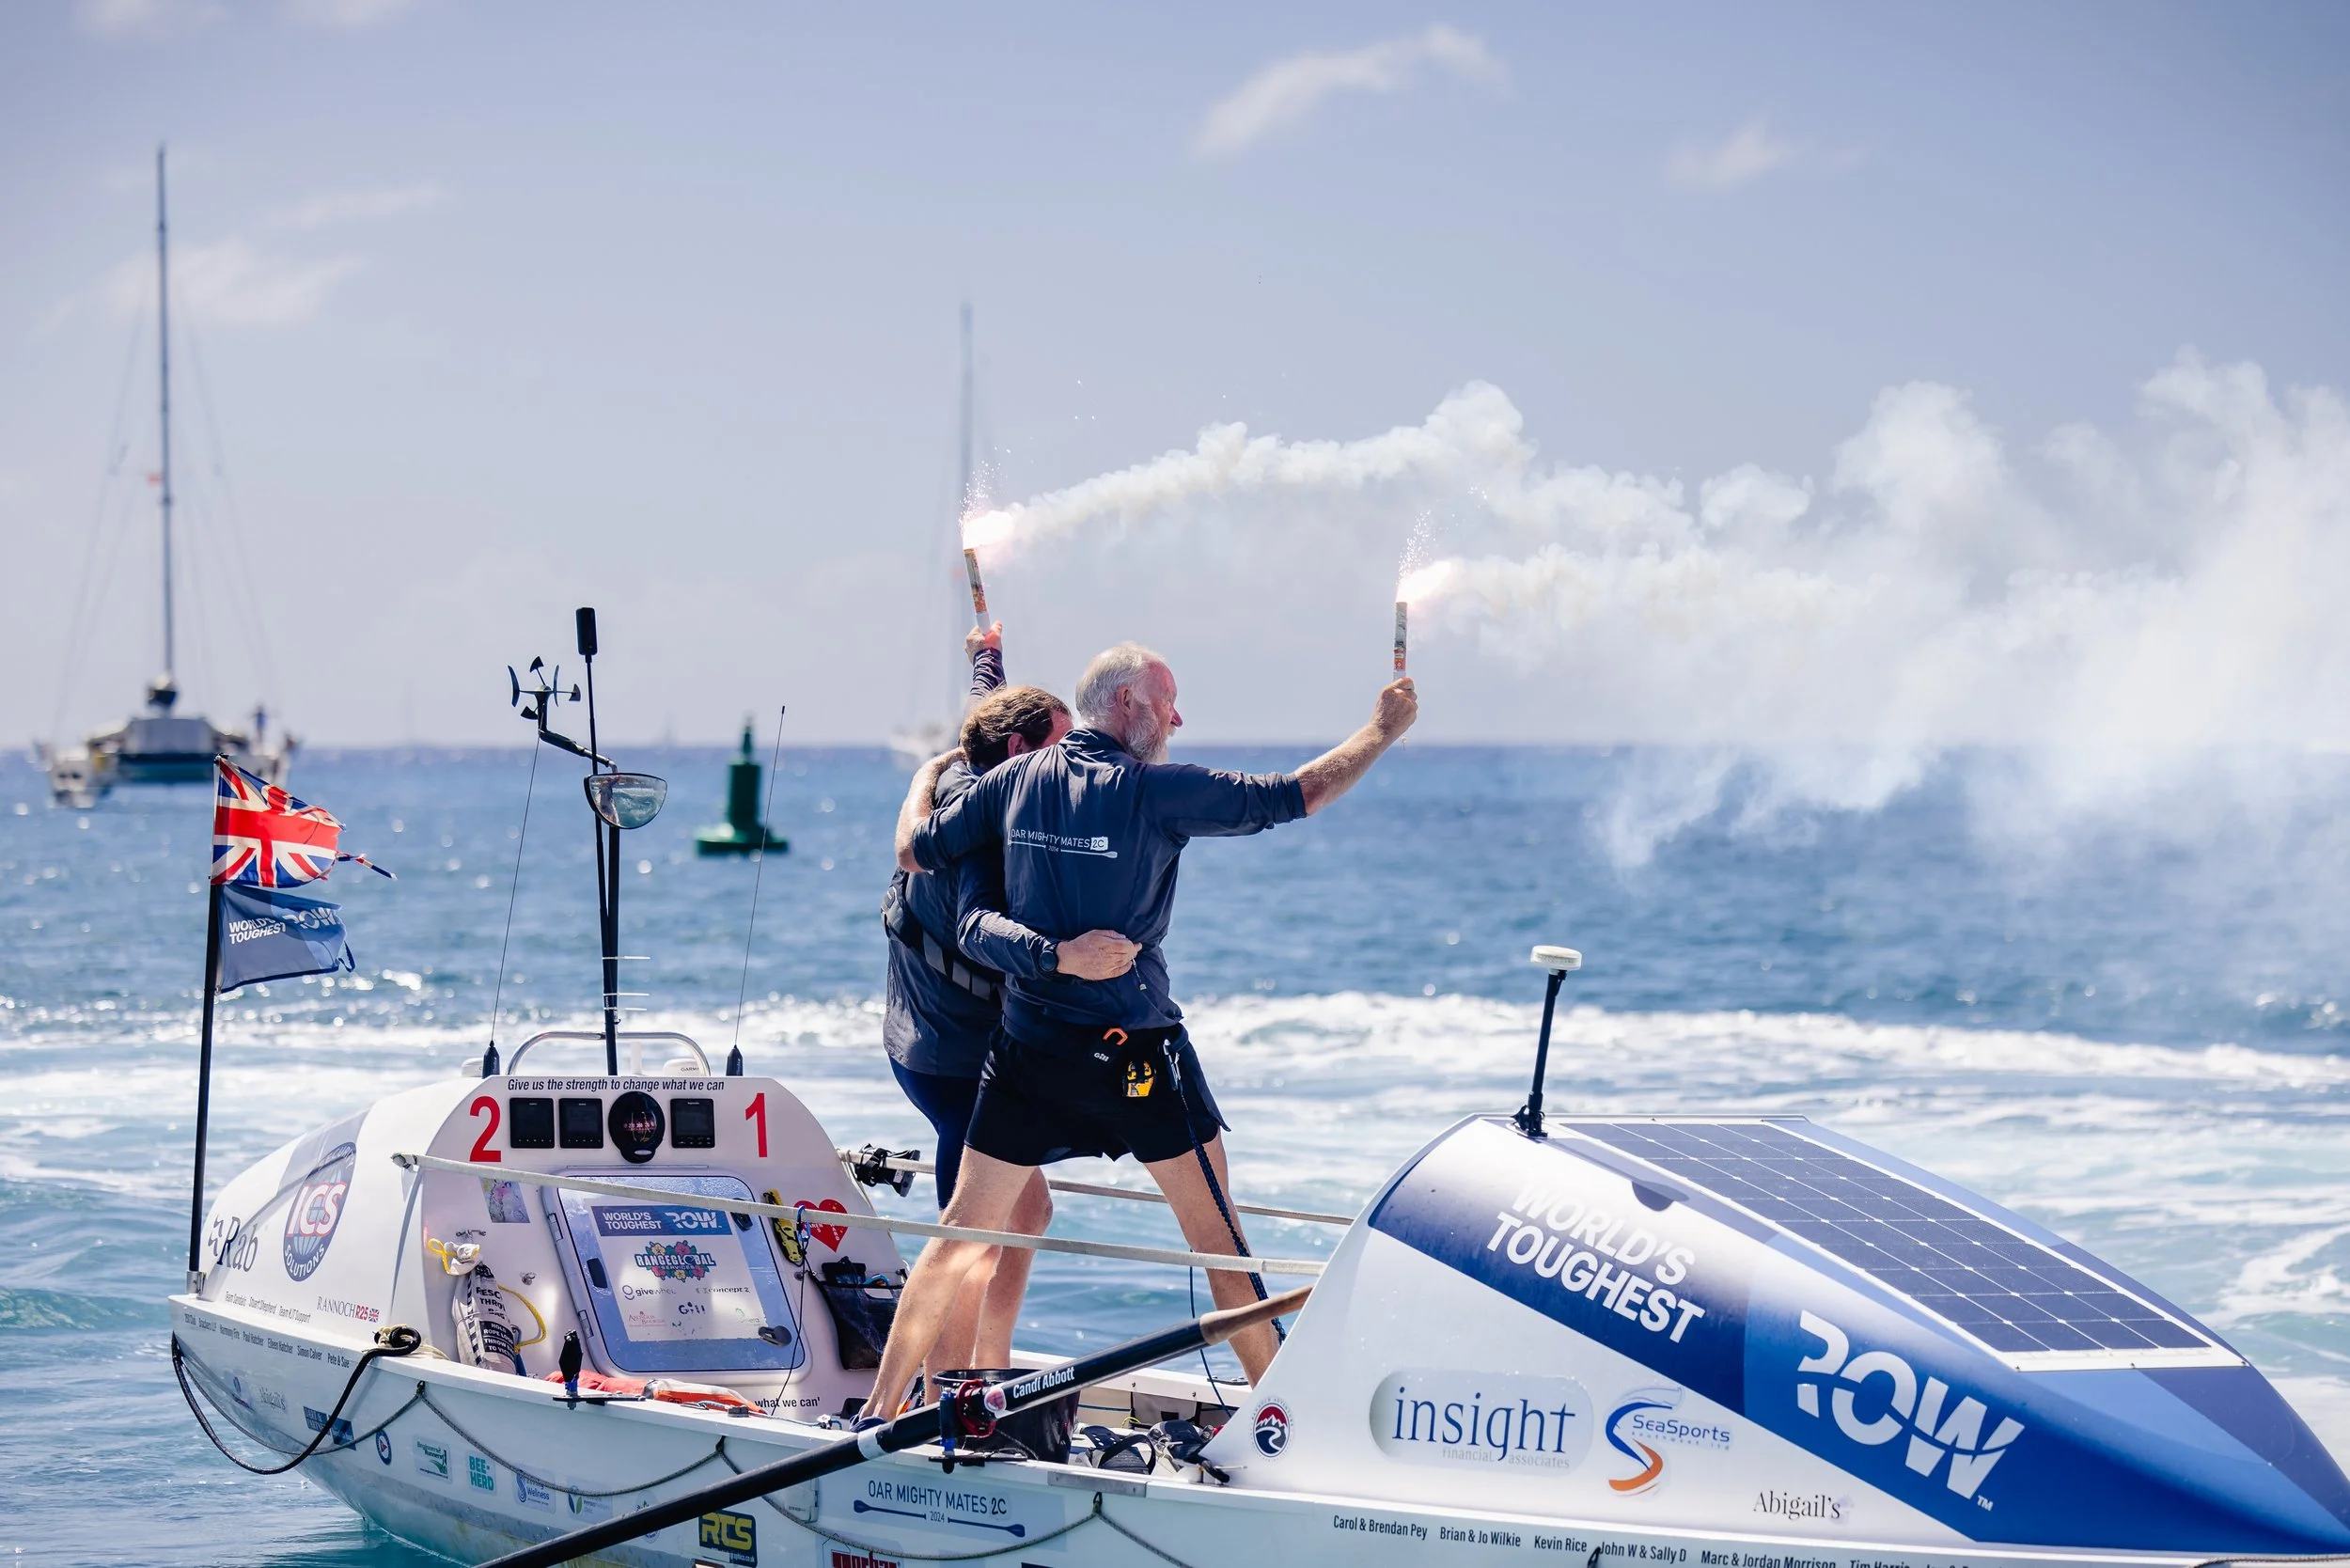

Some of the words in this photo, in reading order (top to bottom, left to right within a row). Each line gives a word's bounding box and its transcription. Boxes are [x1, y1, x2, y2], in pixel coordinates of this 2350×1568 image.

[1010, 828, 1026, 839] OAR
[1027, 830, 1059, 844] MIGHTY
[1061, 837, 1090, 848] MATES
[1092, 839, 1104, 848] 2C
[229, 922, 286, 945] TOUGHEST
[1093, 1052, 1109, 1062] Gill
[508, 1079, 529, 1090] Give
[532, 1081, 544, 1090] us
[547, 1079, 563, 1090] the
[566, 1079, 607, 1092] strength
[611, 1080, 620, 1090] to
[623, 1079, 659, 1092] change
[662, 1079, 686, 1090] what
[689, 1081, 704, 1090] we
[707, 1081, 725, 1090] can
[470, 1096, 501, 1162] 2
[744, 1092, 768, 1158] 1
[286, 1182, 347, 1237] ICS
[603, 1212, 651, 1221] WORLD'S
[665, 1212, 717, 1229] ROW
[604, 1220, 662, 1230] TOUGHEST
[1512, 1181, 1696, 1286] WORLD'S
[217, 1216, 258, 1273] Rab
[285, 1244, 325, 1277] SOLUTIONS
[1486, 1211, 1706, 1343] TOUGHEST
[317, 1296, 356, 1318] RANNOCH
[355, 1305, 369, 1321] R25
[480, 1297, 506, 1312] THRO
[483, 1338, 507, 1348] THROW
[1013, 1377, 1041, 1399] Candi
[1042, 1367, 1075, 1389] Abbott
[755, 1398, 779, 1408] what
[782, 1400, 797, 1408] we
[800, 1397, 821, 1407] can'
[1797, 1309, 2026, 1500] ROW
[1392, 1386, 1575, 1462] insight
[1633, 1415, 1731, 1443] SeaSports
[1442, 1447, 1495, 1463] financial
[1509, 1453, 1570, 1469] associates
[470, 1471, 494, 1491] HERD
[869, 1480, 892, 1499] OAR
[897, 1484, 942, 1507] MIGHTY
[946, 1492, 987, 1514] MATES
[991, 1497, 1007, 1514] 2C
[1753, 1490, 1841, 1521] Abigail's
[931, 1511, 945, 1523] 2024
[1333, 1514, 1357, 1530] Carol
[1359, 1518, 1367, 1531] &
[1369, 1519, 1408, 1536] Brendan
[1410, 1524, 1428, 1541] Pey
[1440, 1527, 1465, 1542] Brian
[1467, 1529, 1476, 1543] &
[1478, 1530, 1488, 1544] Jo
[1490, 1531, 1521, 1547] Wilkie
[1534, 1535, 1562, 1551] Kevin
[1565, 1537, 1587, 1553] Rice
[1599, 1542, 1624, 1557] John
[1627, 1544, 1637, 1558] W
[1639, 1544, 1648, 1559] &
[1650, 1545, 1677, 1564] Sally
[1679, 1549, 1686, 1562] D
[1701, 1550, 1729, 1565] Marc
[1731, 1553, 1740, 1566] &
[1742, 1553, 1780, 1568] Jordan
[1783, 1557, 1837, 1568] Morrison
